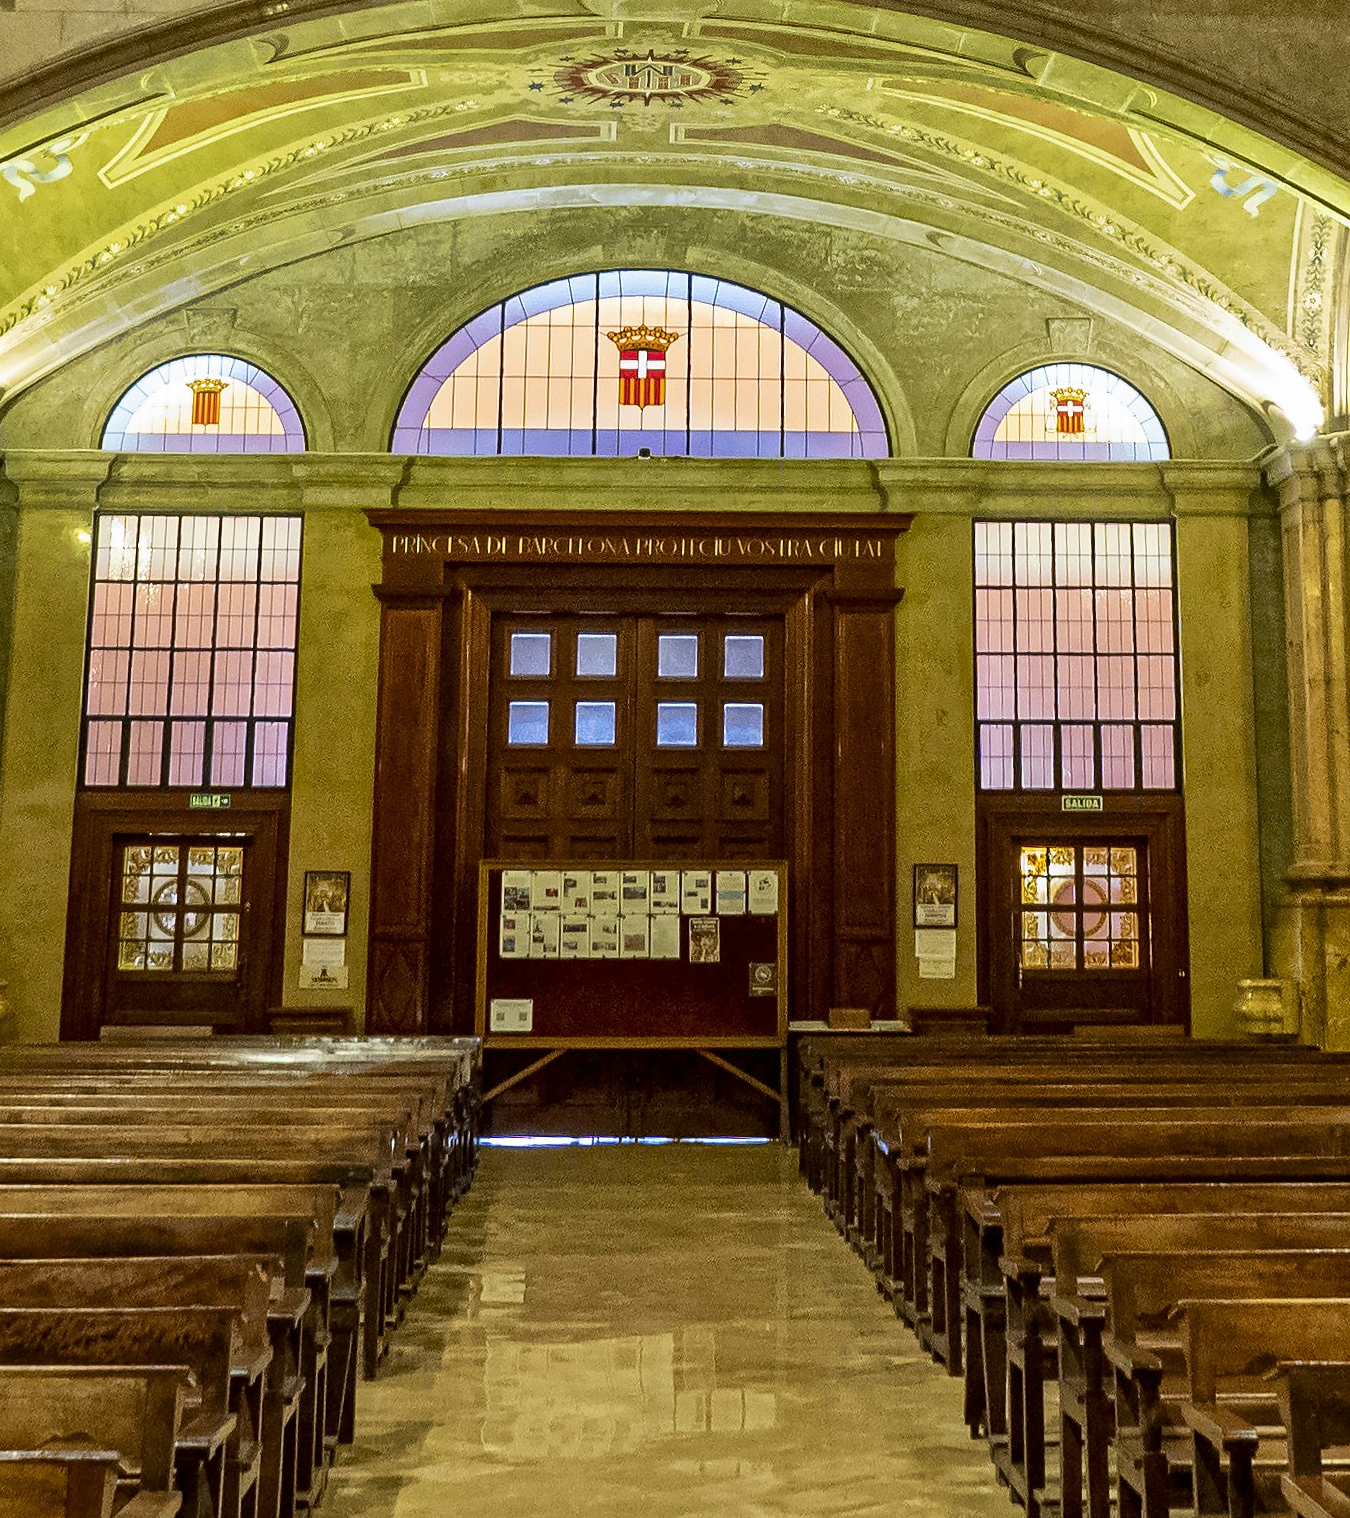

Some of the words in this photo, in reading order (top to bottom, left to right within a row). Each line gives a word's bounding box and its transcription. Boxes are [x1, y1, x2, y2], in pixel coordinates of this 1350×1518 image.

[392, 534, 480, 554] PRINCESA
[487, 535, 507, 554] DE
[518, 536, 630, 555] BARCELONA
[737, 538, 812, 557] VOSTRA
[1065, 798, 1100, 809] SALIDA
